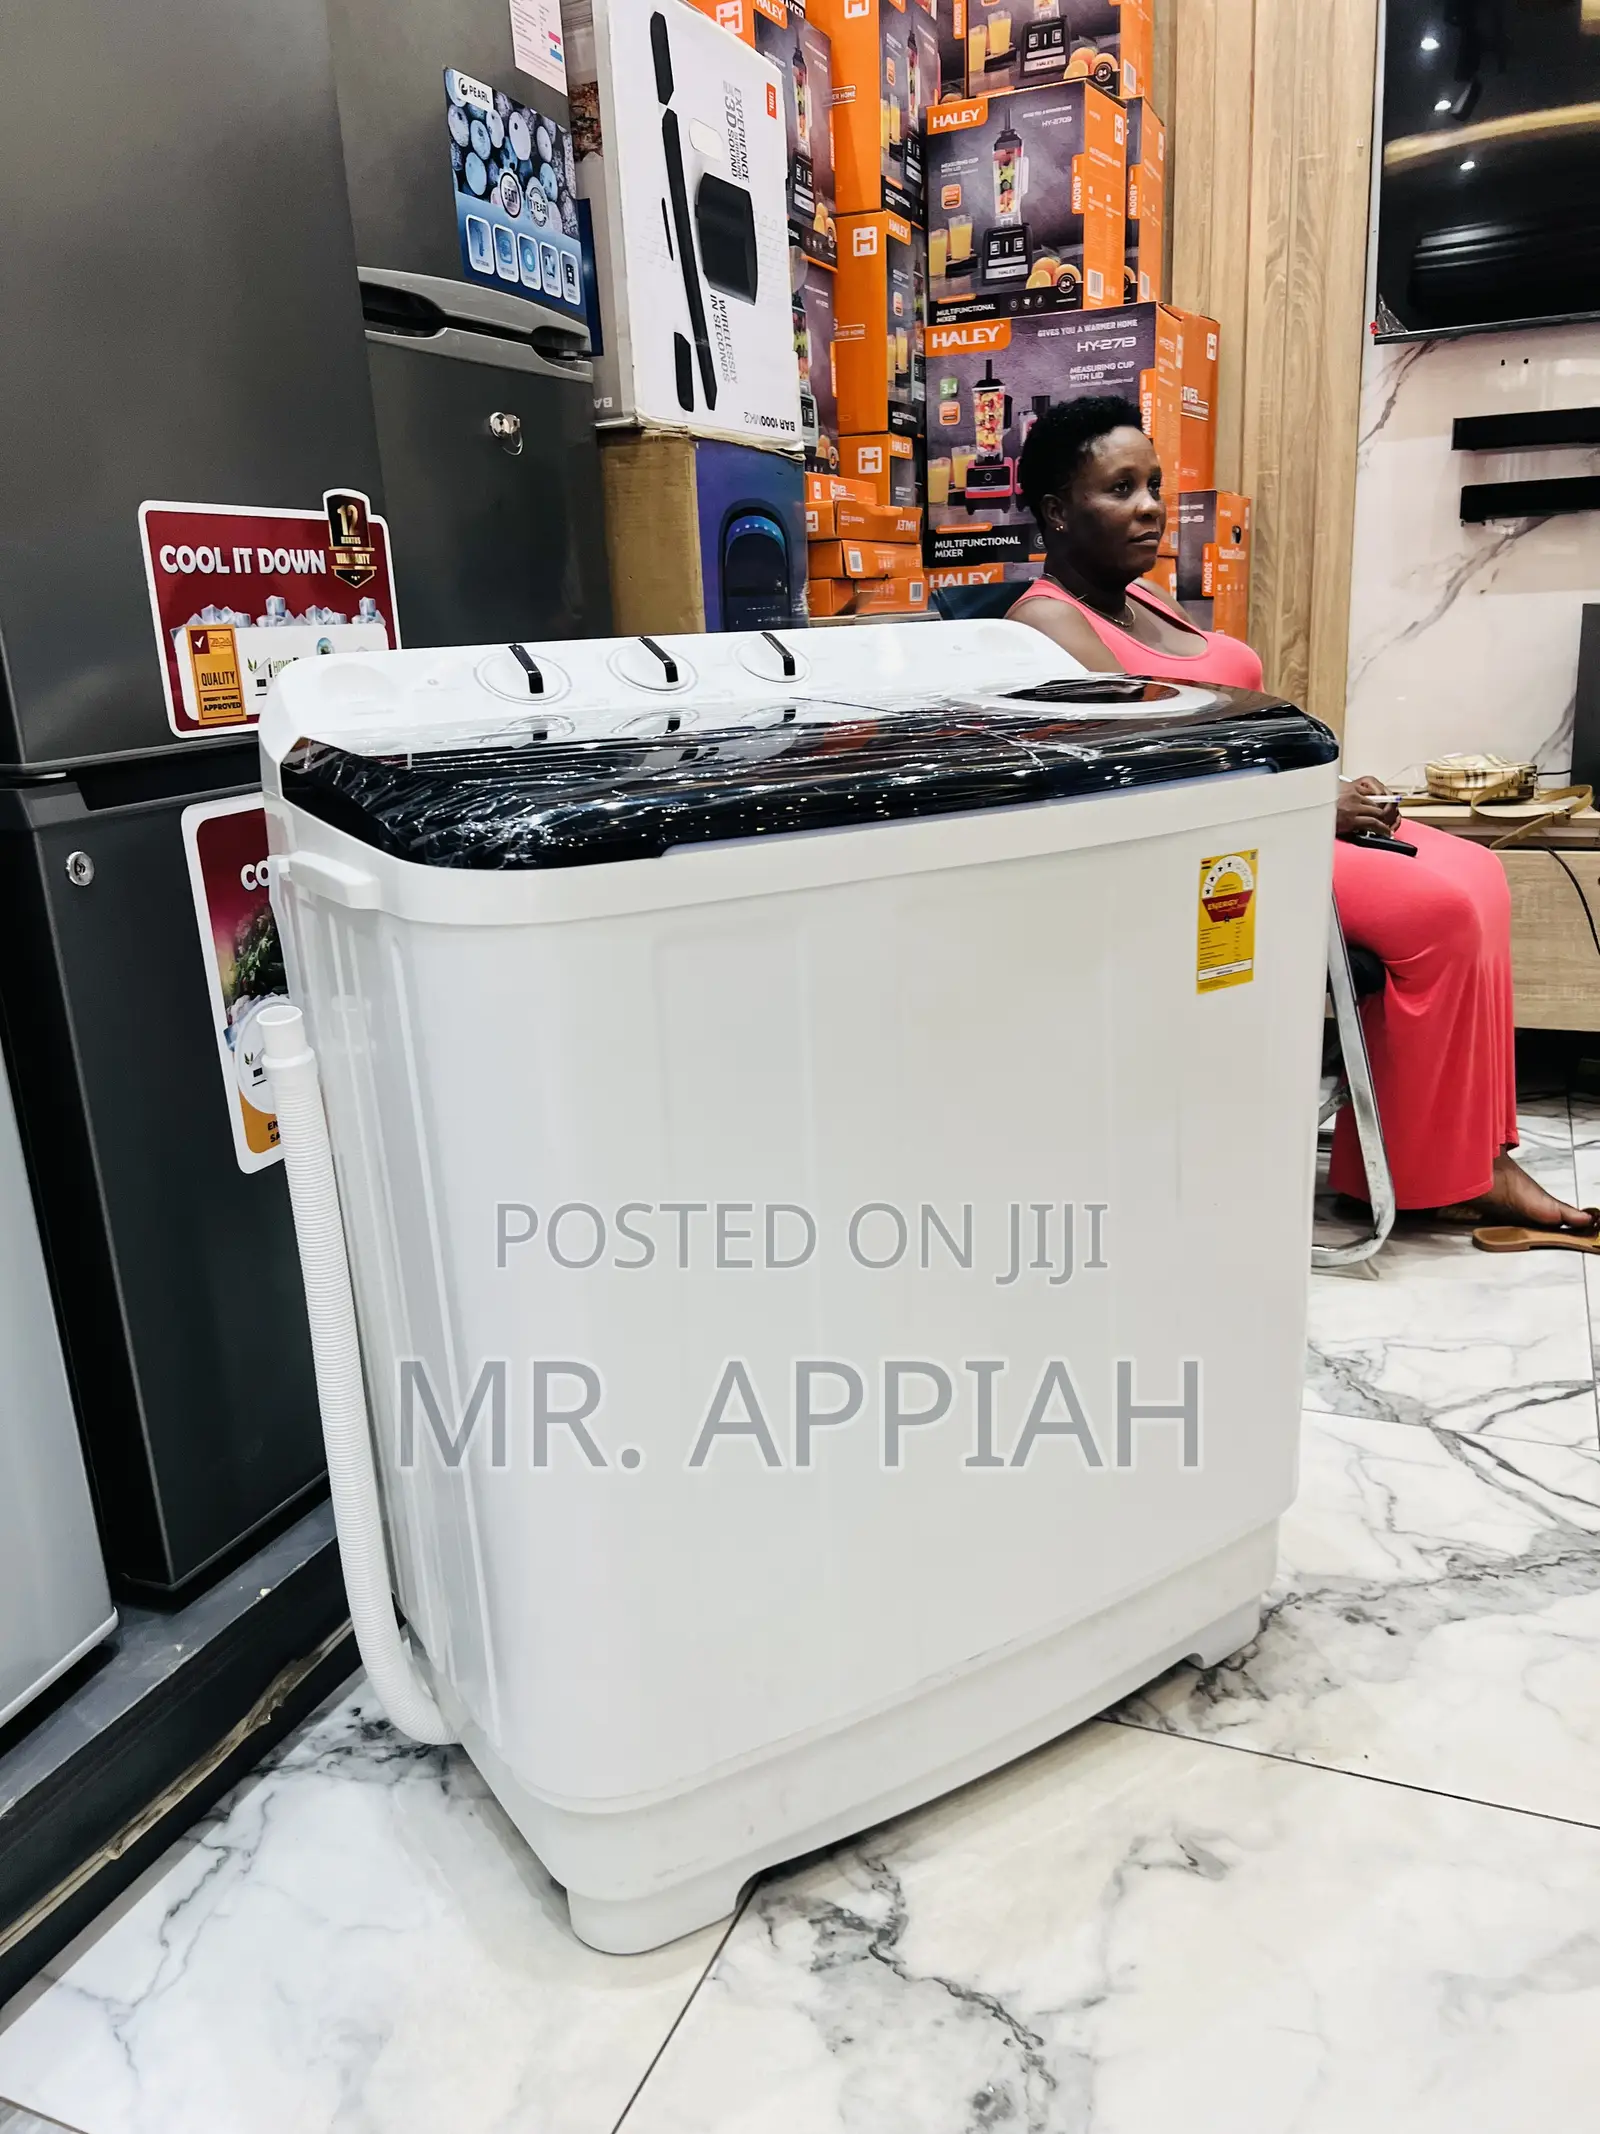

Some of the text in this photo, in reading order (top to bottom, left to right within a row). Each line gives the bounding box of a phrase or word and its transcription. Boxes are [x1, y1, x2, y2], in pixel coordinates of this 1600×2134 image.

[469, 85, 490, 104] PEARL
[725, 96, 737, 128] 3D
[932, 108, 980, 129] HALEY
[734, 87, 750, 183] EXPERIENCE
[728, 128, 738, 178] SOUND
[1073, 176, 1082, 210] 4800W
[710, 294, 730, 383] IN SECONDS
[932, 325, 1000, 348] HALEY
[1037, 328, 1059, 337] GIVES
[1061, 326, 1076, 335] YOU
[1117, 319, 1138, 328] HOME
[719, 299, 738, 384] WIRELESSLY
[1070, 361, 1135, 374] MEASURING CUP
[1070, 371, 1104, 381] WITH LID
[780, 418, 795, 432] BAR
[337, 504, 358, 535] 12
[935, 535, 1021, 549] MULTIFUNCTIONAL
[159, 545, 327, 574] COOL IT DOWN
[935, 548, 964, 558] MIXER
[201, 671, 235, 687] QUALITY
[203, 701, 242, 712] APPROVED
